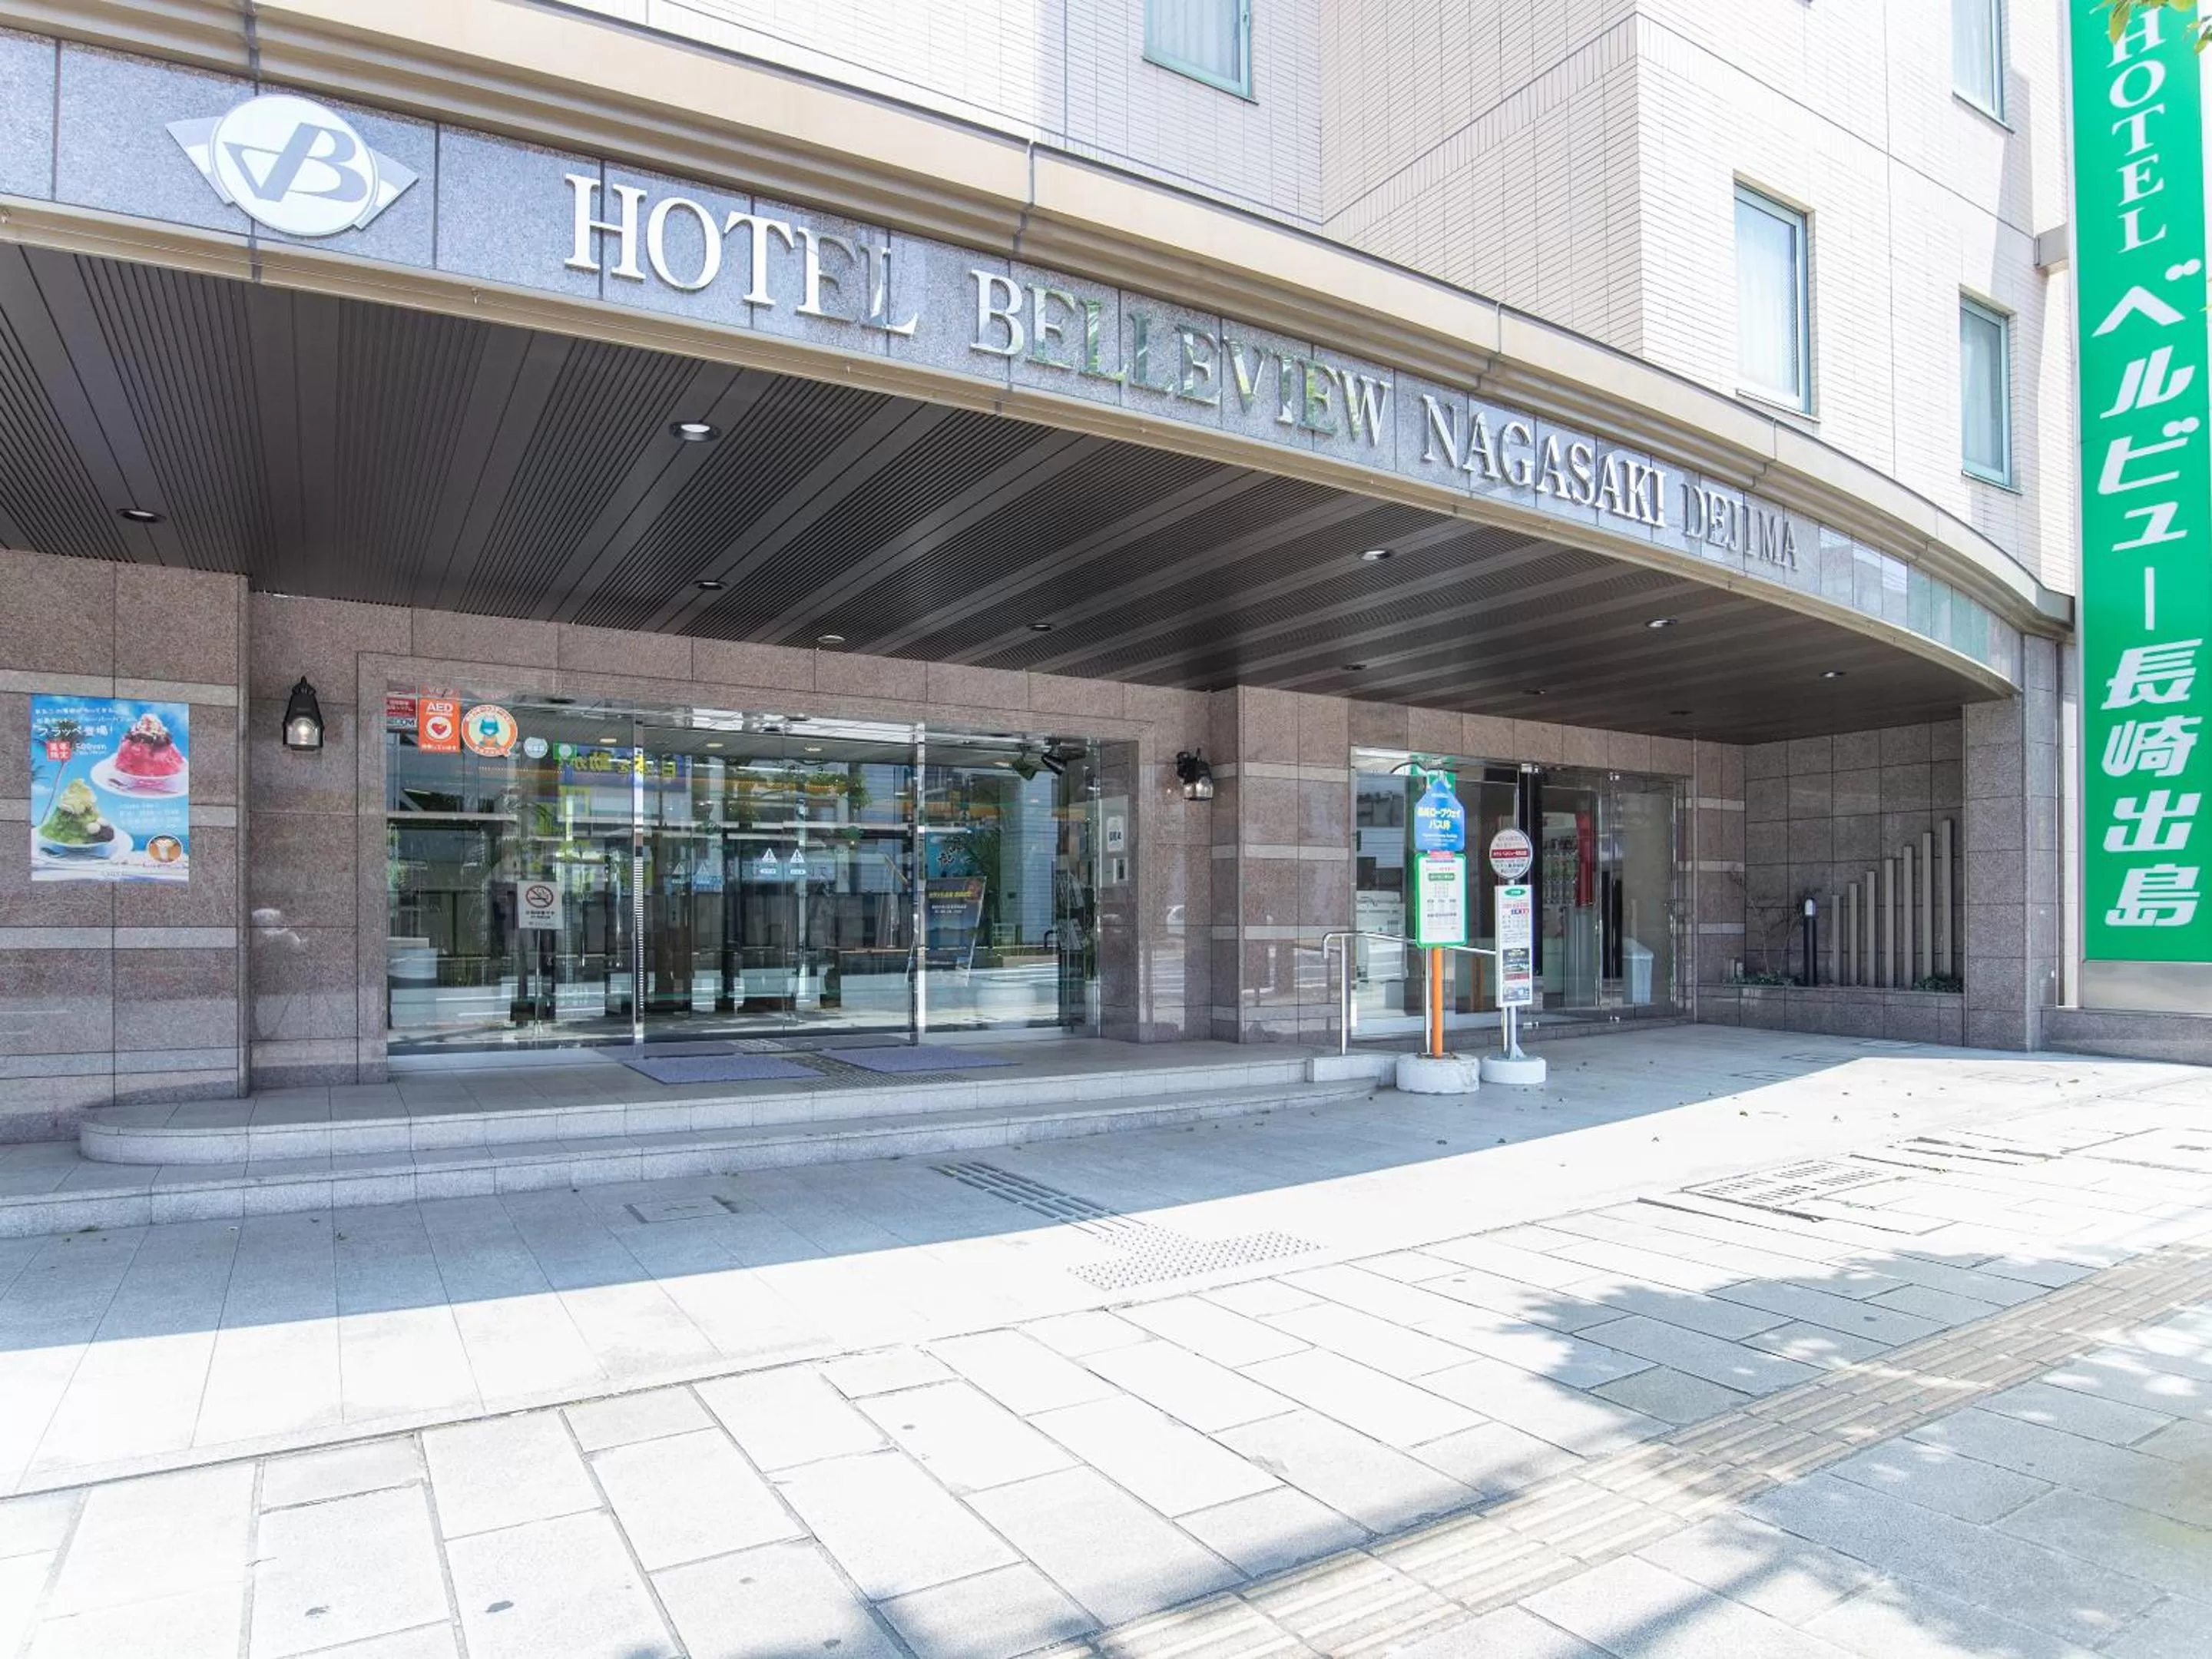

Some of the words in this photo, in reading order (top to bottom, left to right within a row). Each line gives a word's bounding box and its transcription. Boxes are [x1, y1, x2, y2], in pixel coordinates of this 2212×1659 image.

[2105, 5, 2167, 254] HOTEL
[562, 173, 918, 337] HOTEL
[968, 267, 1392, 448] BELLEVIEW
[1420, 392, 1667, 530] NAGASAKI
[1681, 482, 1800, 571] DEJIMA
[426, 702, 454, 713] AED
[2091, 259, 2203, 927] ベルビュー長崎出島
